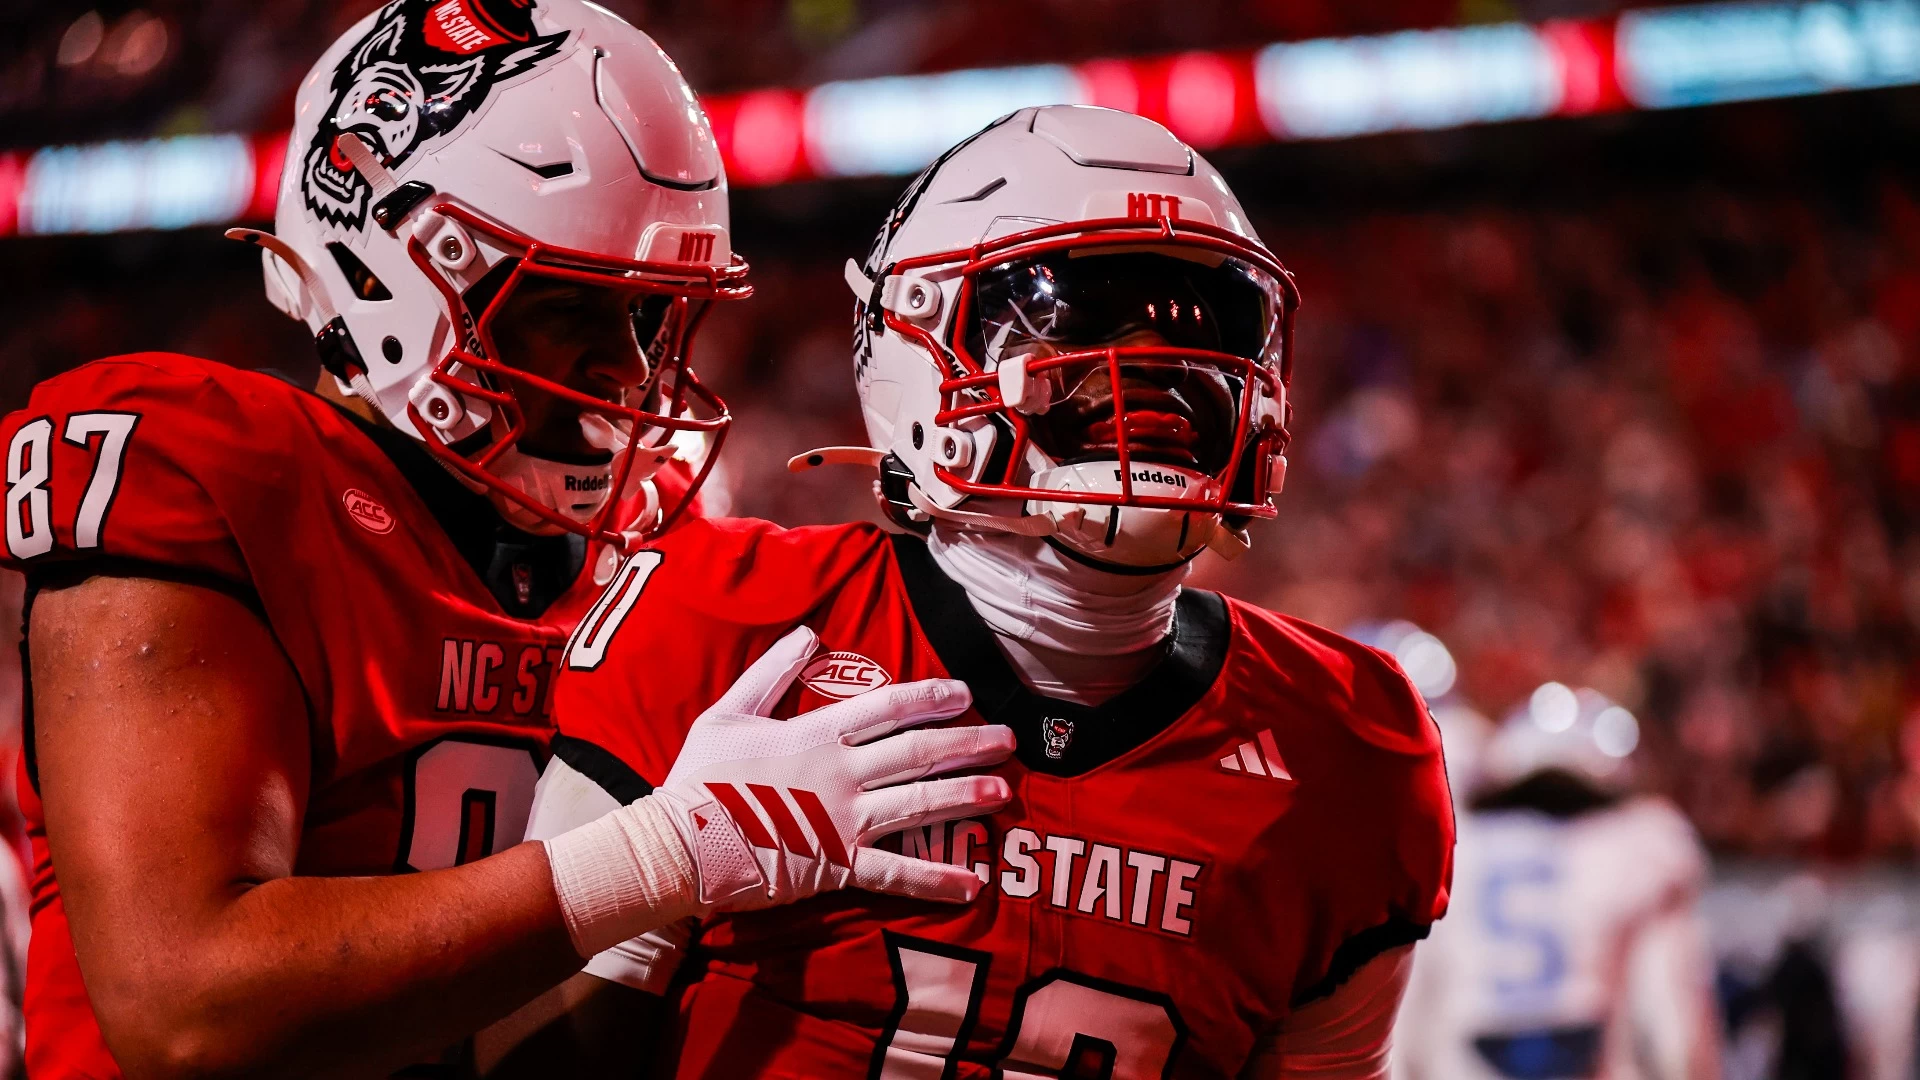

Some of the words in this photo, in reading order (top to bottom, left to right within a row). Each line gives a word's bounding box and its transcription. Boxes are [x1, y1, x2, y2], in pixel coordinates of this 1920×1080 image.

[440, 16, 491, 50] STATE
[1127, 192, 1182, 219] HTT
[5, 412, 140, 561] 87
[350, 500, 385, 520] ACC
[560, 550, 663, 670] 0
[436, 639, 504, 712] NC
[811, 663, 878, 683] ACC
[888, 684, 953, 706] ADIZERO
[1000, 827, 1201, 935] STATE
[1478, 859, 1567, 1010] 5
